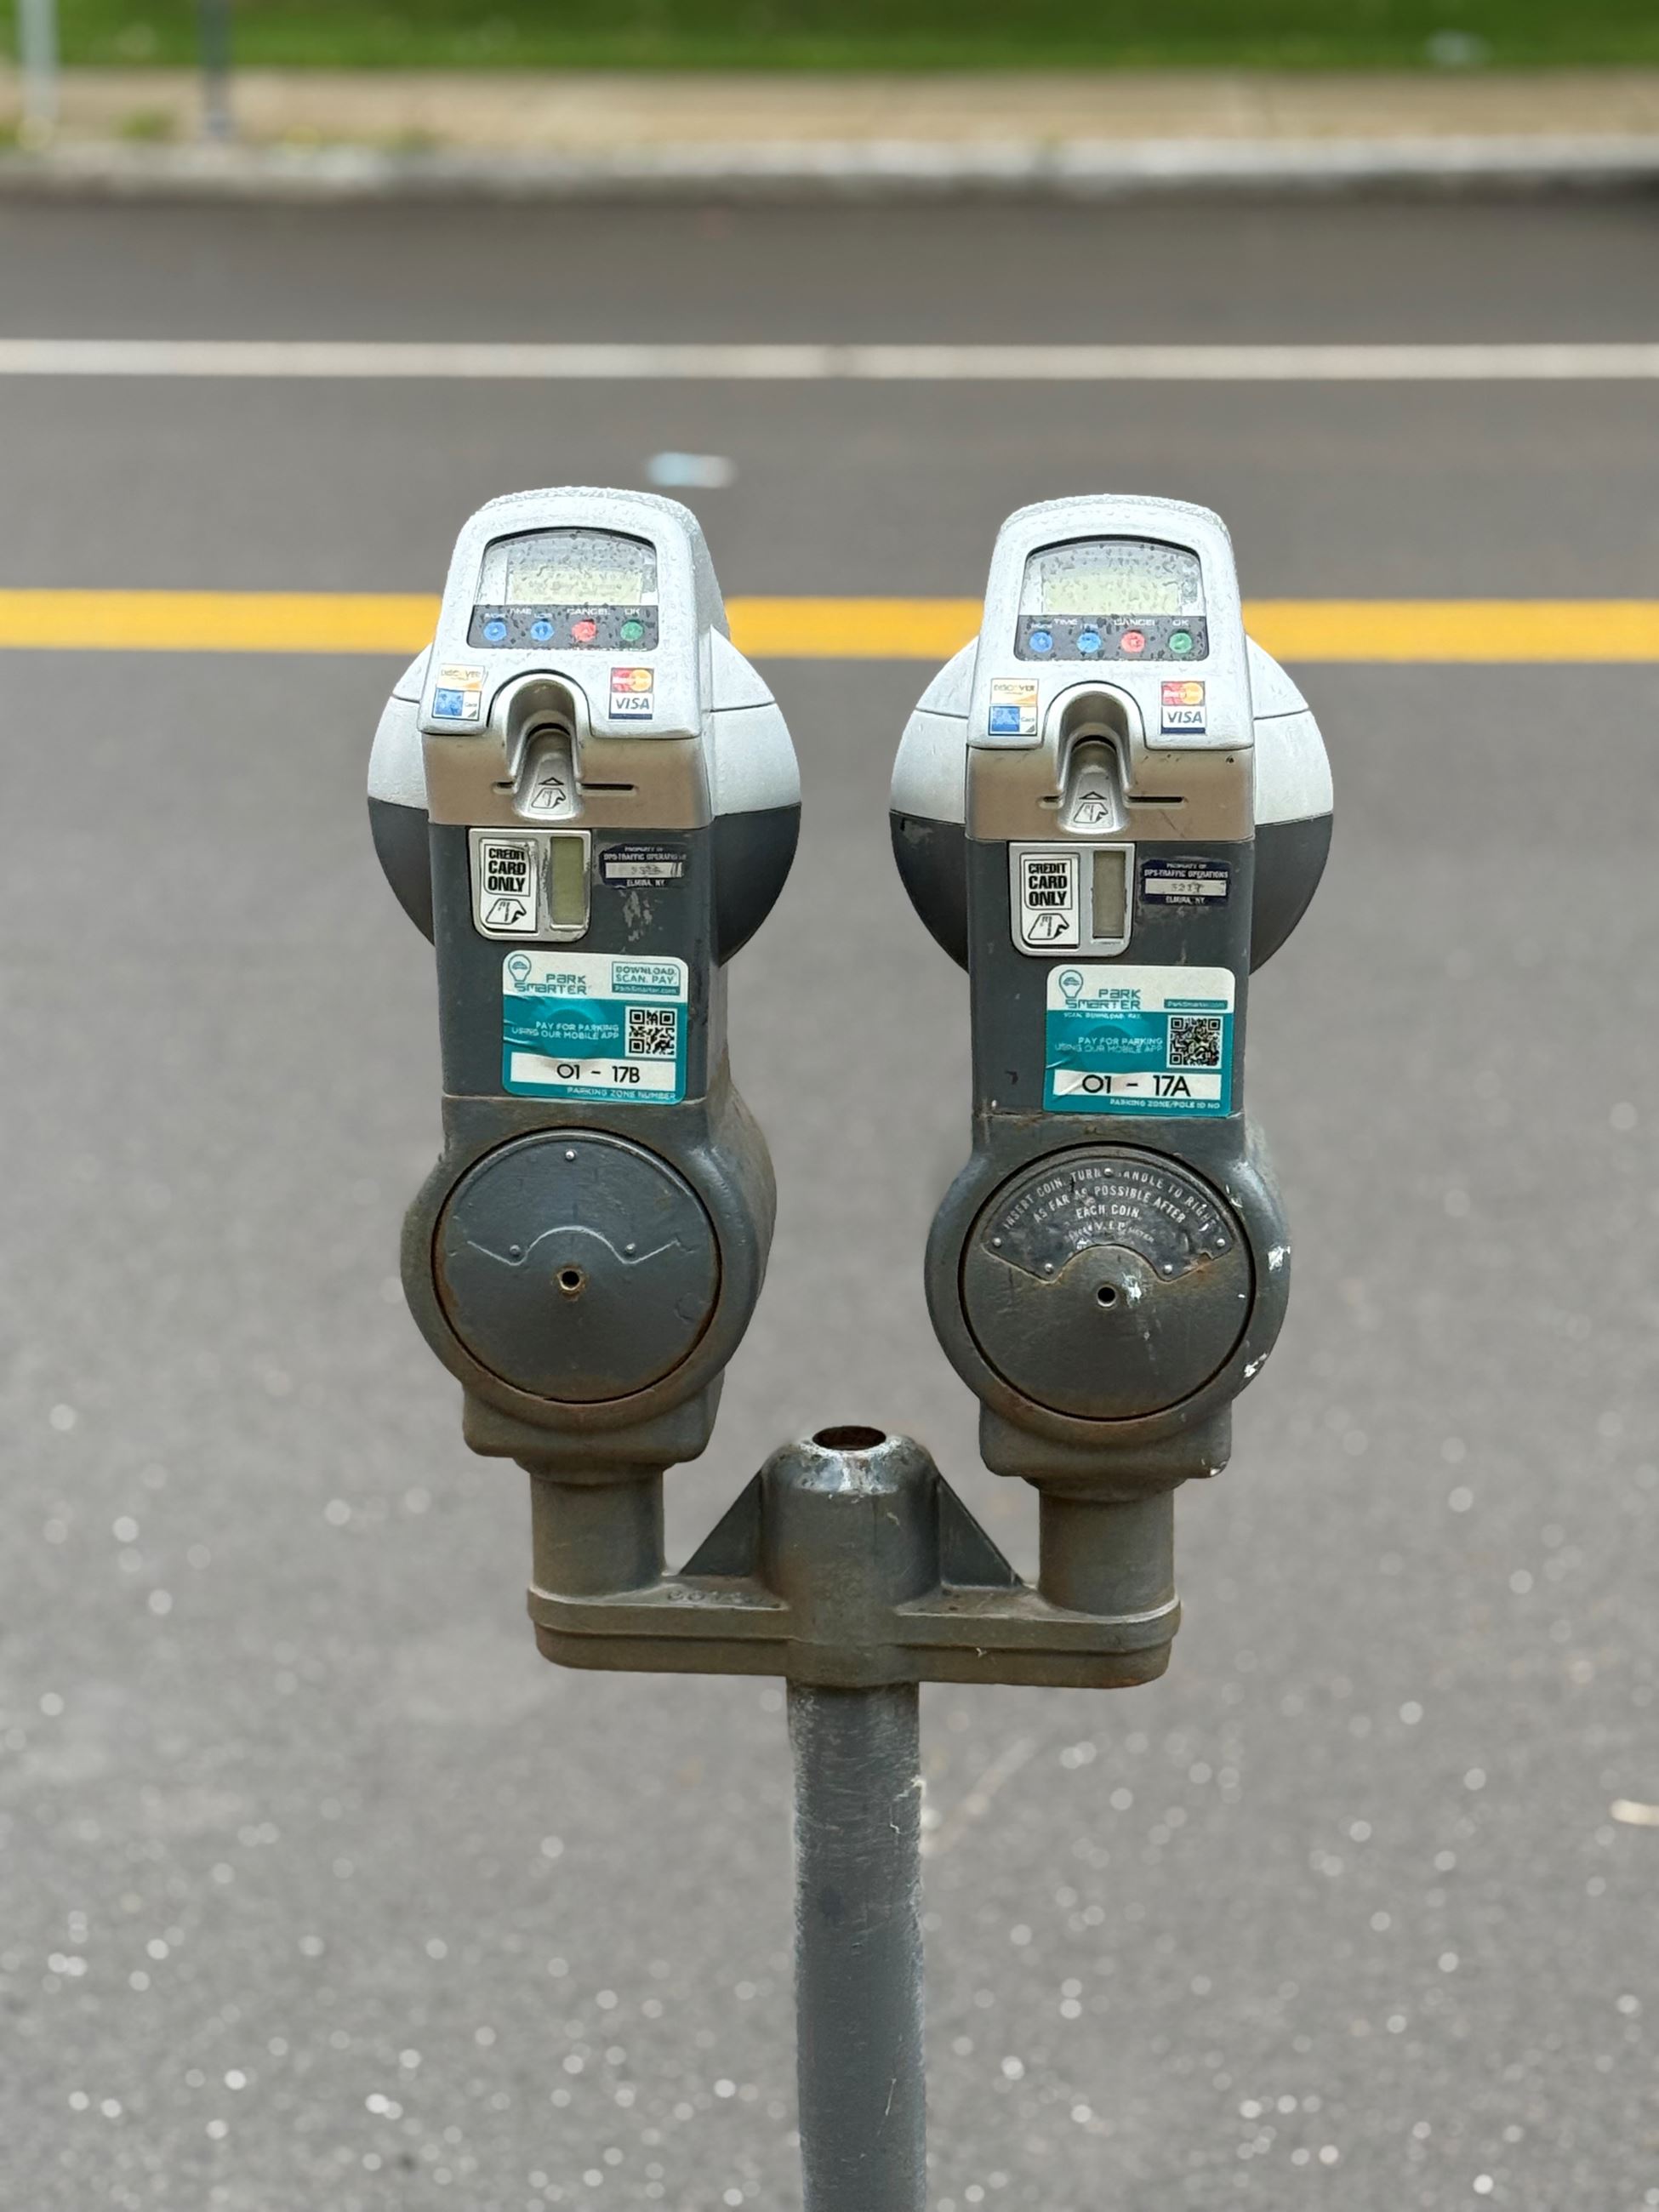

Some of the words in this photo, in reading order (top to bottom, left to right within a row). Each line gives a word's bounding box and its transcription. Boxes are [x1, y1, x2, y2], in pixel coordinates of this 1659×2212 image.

[441, 669, 481, 679] DISCVER
[993, 684, 1035, 693] DISCVER
[615, 697, 650, 710] VISA
[1167, 711, 1202, 723] VISA
[488, 847, 525, 861] CREDIT
[488, 860, 527, 875] CARD
[1028, 863, 1068, 875] CREDIT
[1188, 870, 1228, 879] OPERATIONS
[487, 875, 526, 892] ONLY
[1028, 875, 1068, 890] CARD
[1029, 891, 1068, 907] ONLY
[536, 1021, 555, 1029] PAY
[556, 1023, 576, 1031] FOR
[541, 1029, 562, 1038] OUR
[563, 1031, 599, 1040] MOBILE
[1121, 1038, 1163, 1046] PARKING
[1108, 1046, 1141, 1054] MOBILE
[612, 1065, 640, 1083] 17B
[1153, 1075, 1191, 1097] 17A
[567, 1086, 607, 1097] PARKING
[610, 1090, 635, 1098] ZONE
[638, 1092, 676, 1101] NUMBER
[1109, 1098, 1146, 1108] PARKING
[1004, 1194, 1034, 1229] INSERT
[1069, 1168, 1102, 1183] TURN
[1117, 1171, 1164, 1189] ANDLE
[1168, 1183, 1183, 1198] TO
[1184, 1196, 1219, 1227] RIGHT
[1033, 1208, 1048, 1223] AS
[1047, 1194, 1070, 1211] FAR
[1074, 1187, 1089, 1201] AS
[1094, 1184, 1151, 1204] POSSIBLE
[1153, 1196, 1186, 1223] AFTER
[1075, 1204, 1106, 1219] EACH
